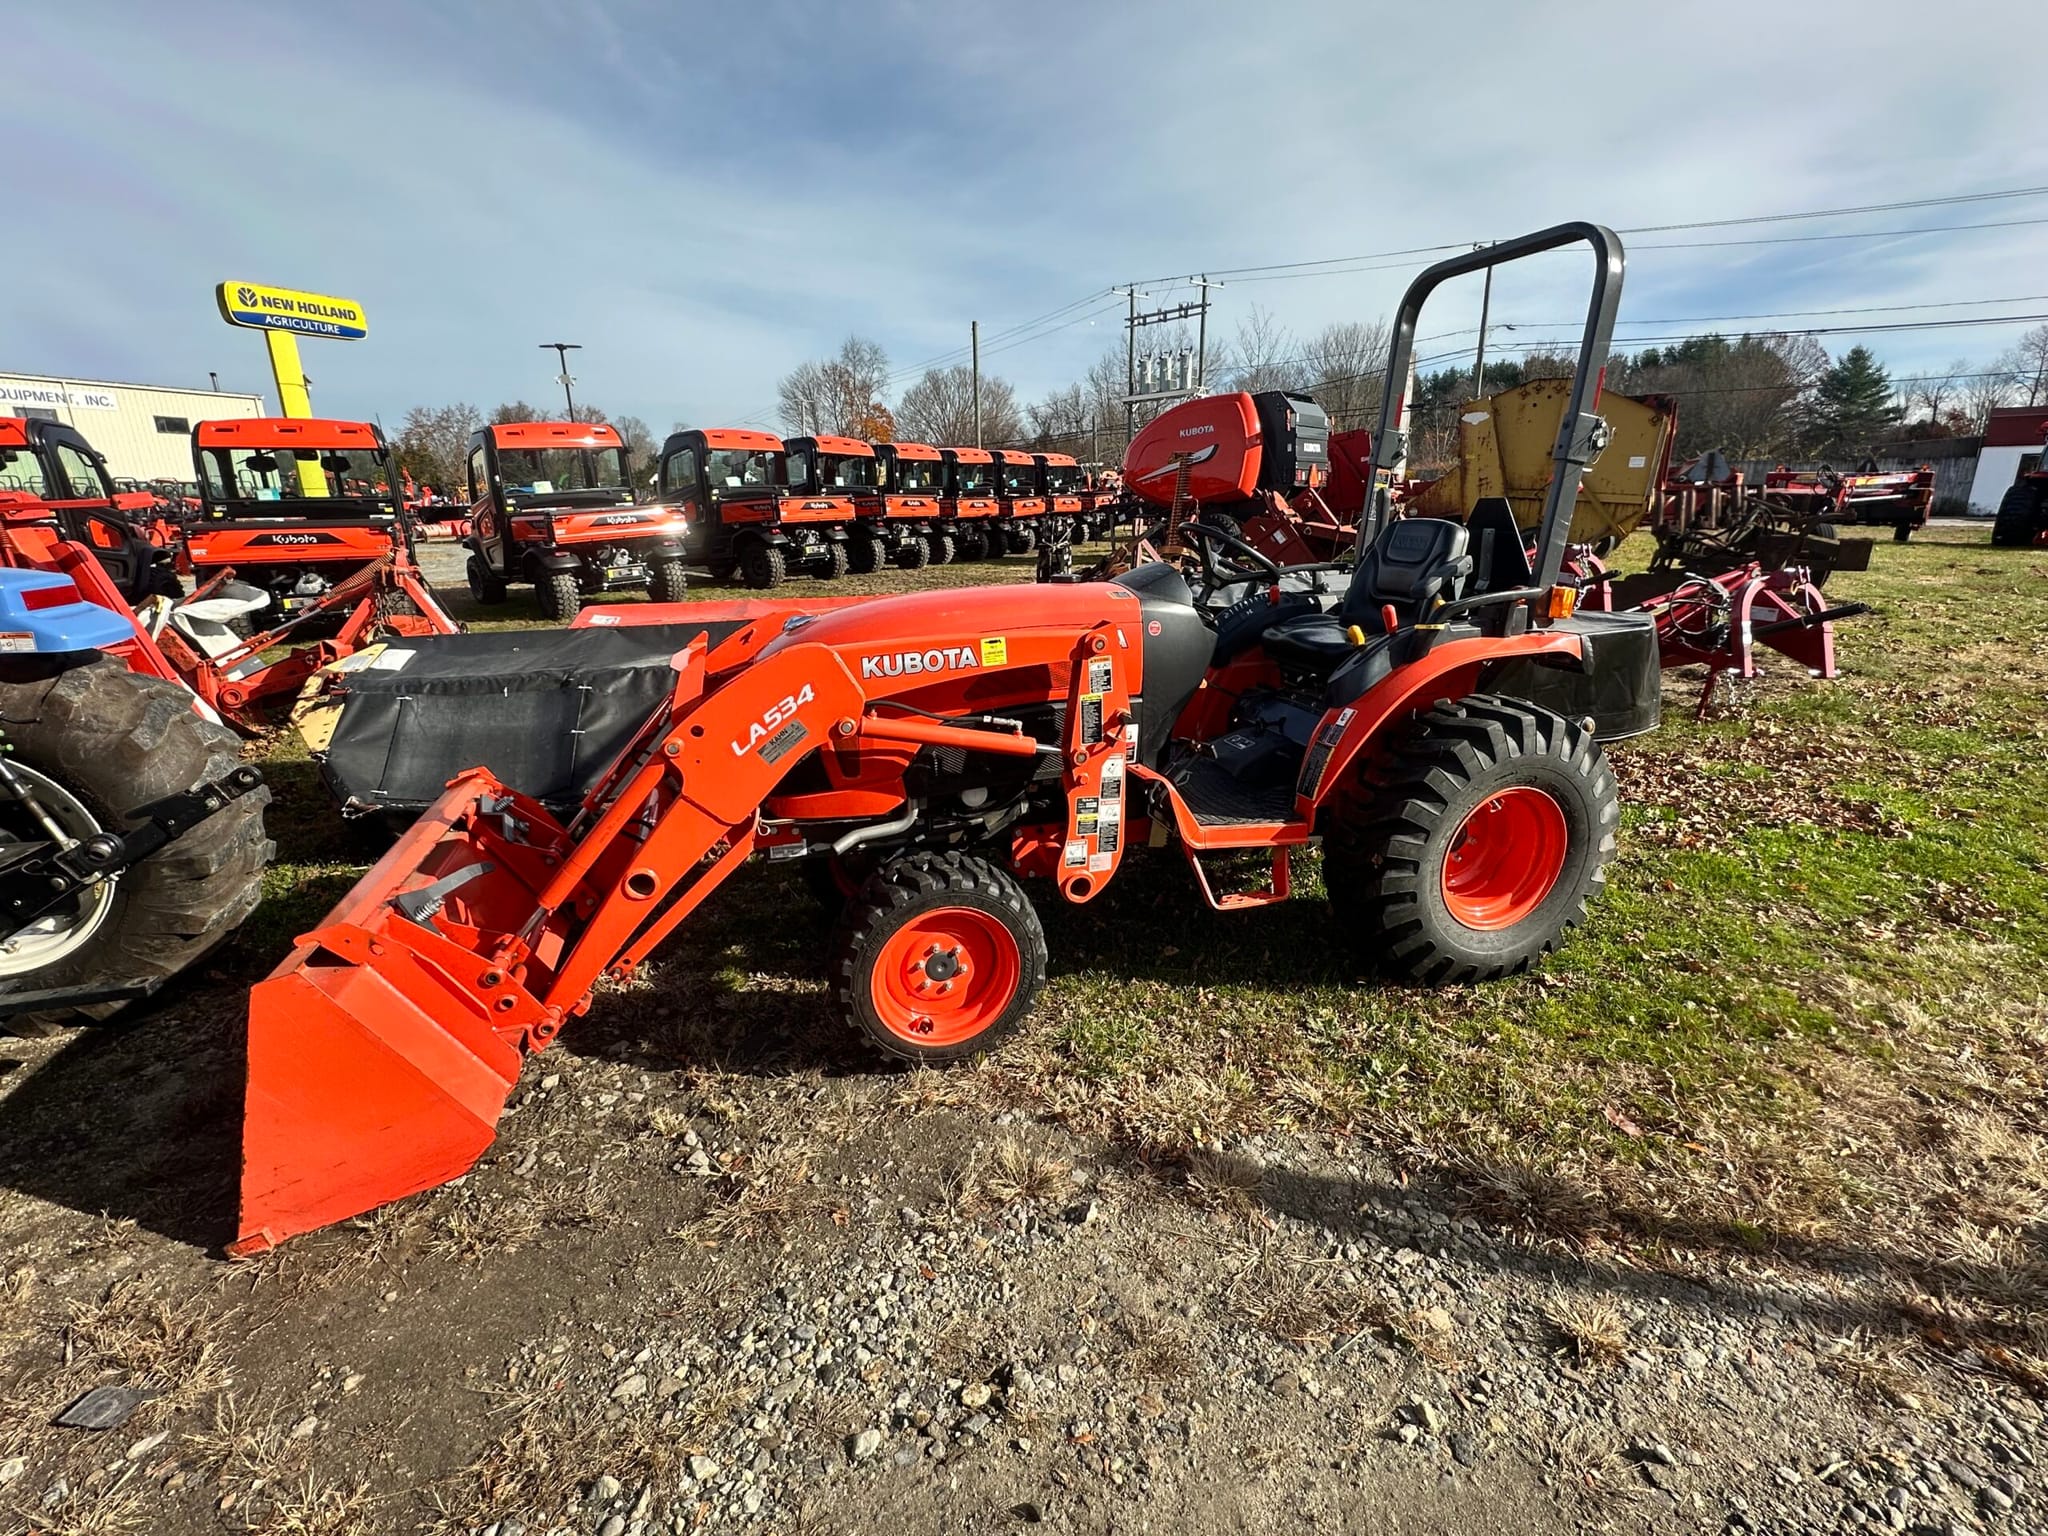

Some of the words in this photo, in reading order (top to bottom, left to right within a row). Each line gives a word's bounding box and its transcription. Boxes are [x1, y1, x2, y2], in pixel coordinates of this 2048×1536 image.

[261, 295, 294, 311] NEW
[297, 301, 357, 321] HOLLAND
[265, 315, 341, 334] AGRICULTURE
[85, 394, 115, 407] INC.
[1179, 424, 1215, 438] KUBOTA
[606, 515, 638, 524] Kubota
[272, 534, 318, 545] Kubota
[861, 645, 980, 679] KUBOTA
[730, 683, 816, 757] LA534
[768, 726, 789, 747] KAHN
